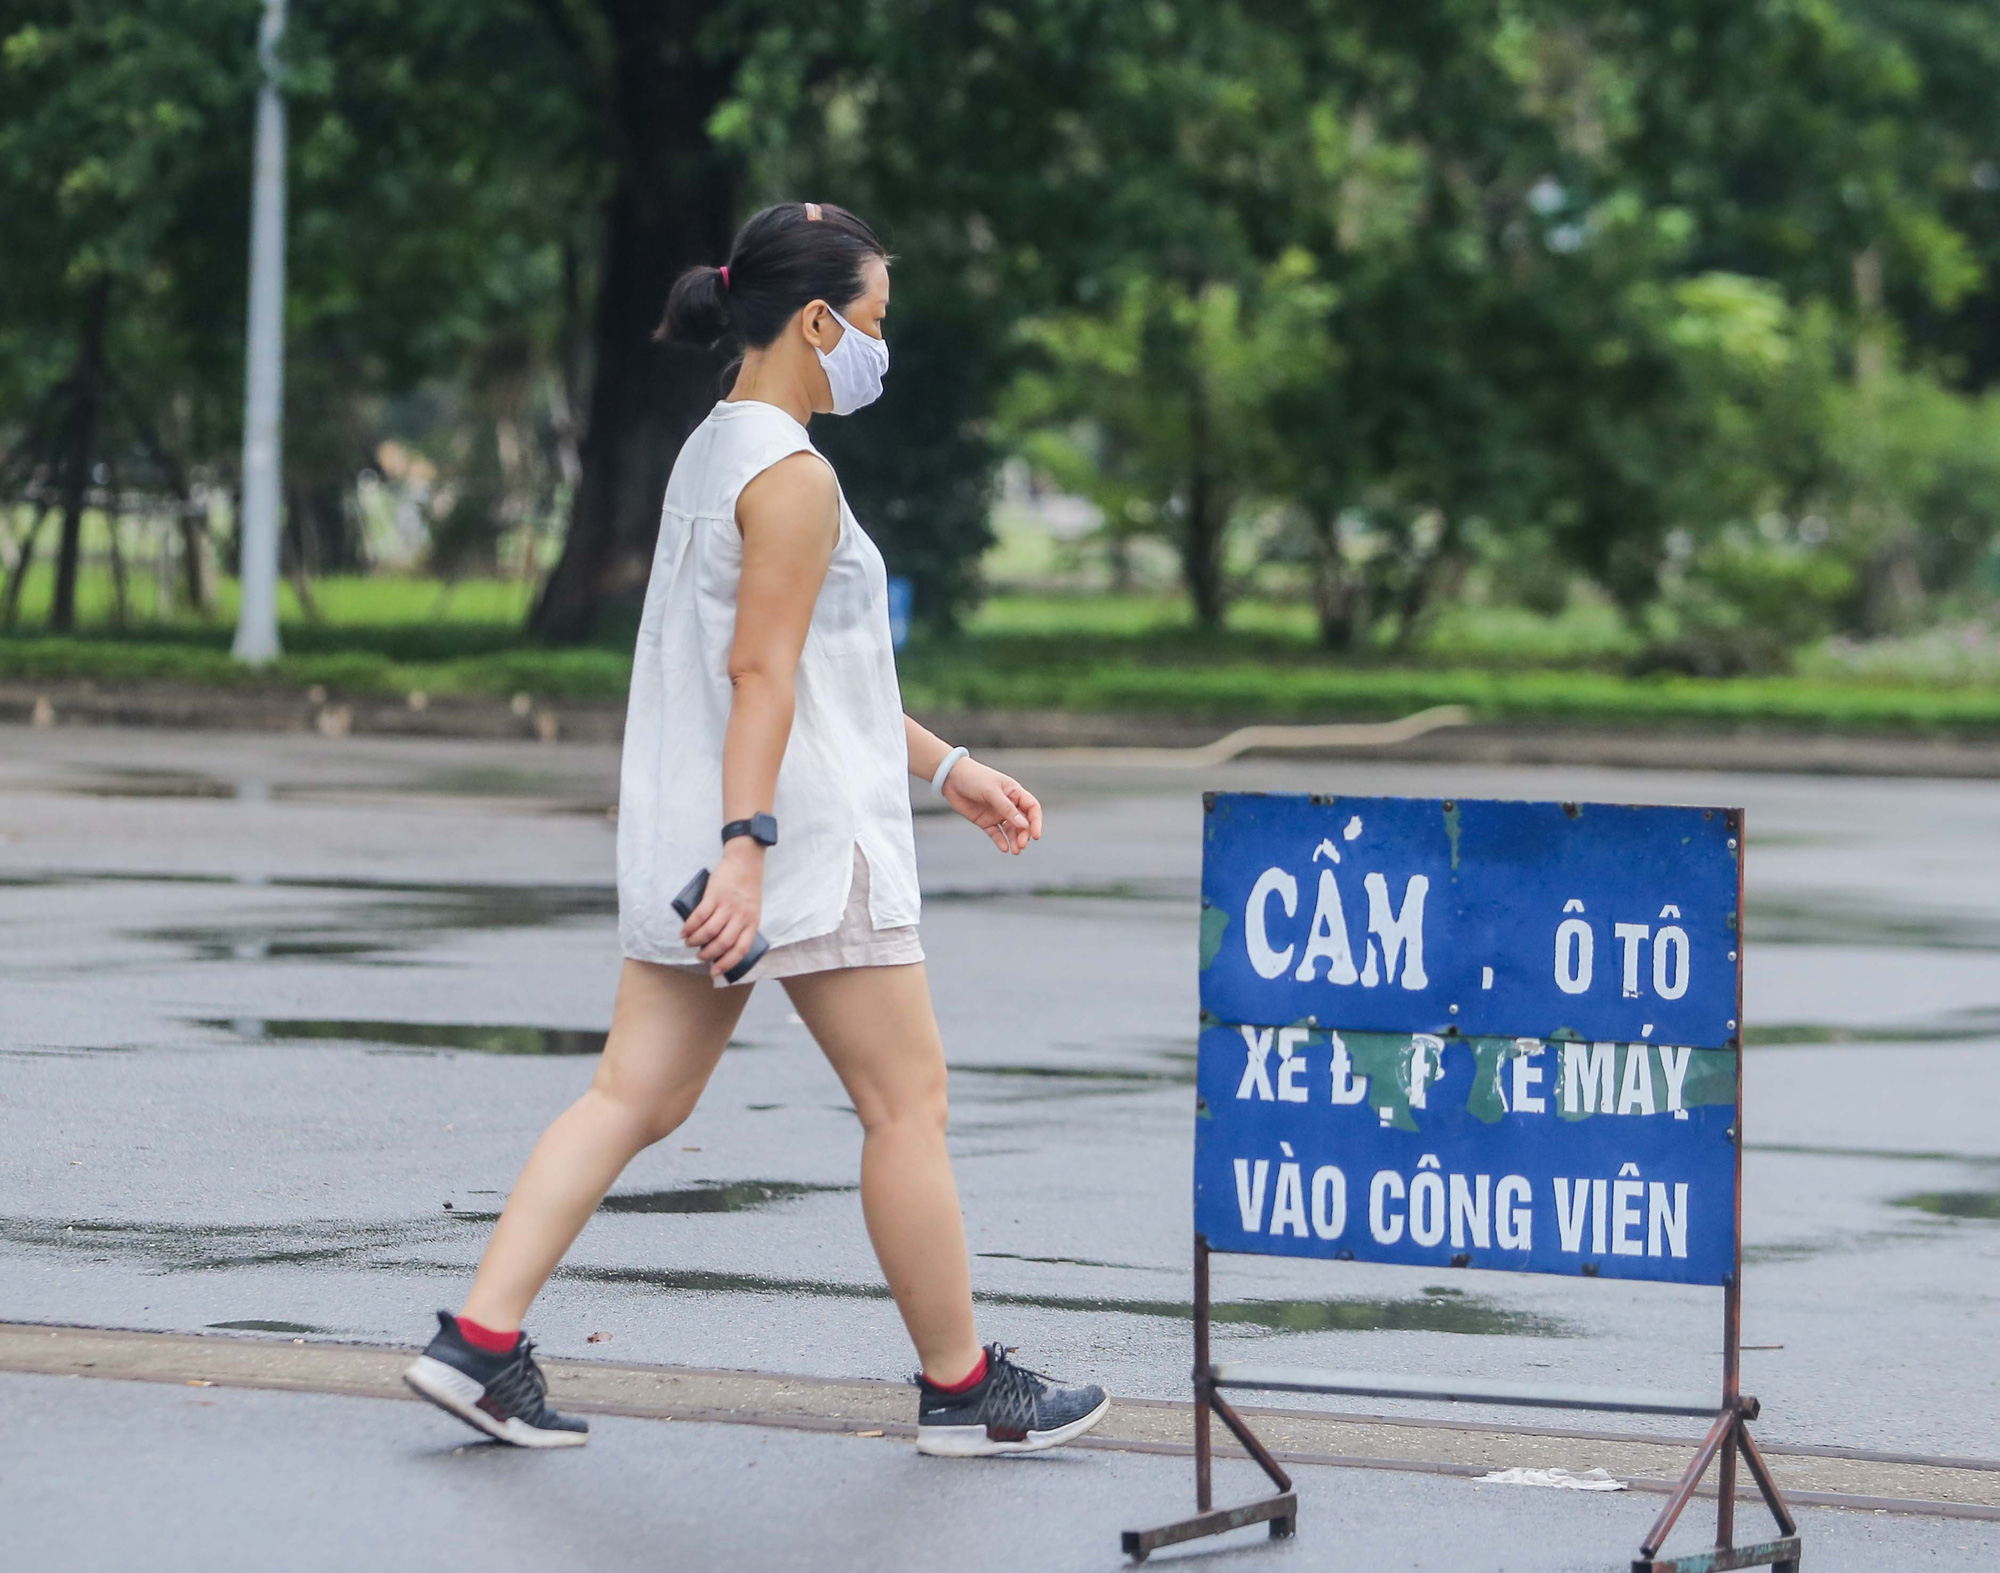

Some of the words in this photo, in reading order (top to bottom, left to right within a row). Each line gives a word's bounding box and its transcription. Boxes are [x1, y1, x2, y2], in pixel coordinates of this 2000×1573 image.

[1244, 815, 1430, 991] CẤM
[1554, 898, 1594, 995] Ô
[1615, 904, 1690, 1000] TÔ
[1236, 1024, 1310, 1103] XE
[1233, 1141, 1347, 1240] VÀO
[1369, 1154, 1533, 1250] CÔNG
[1553, 1162, 1689, 1258] VIÊN
